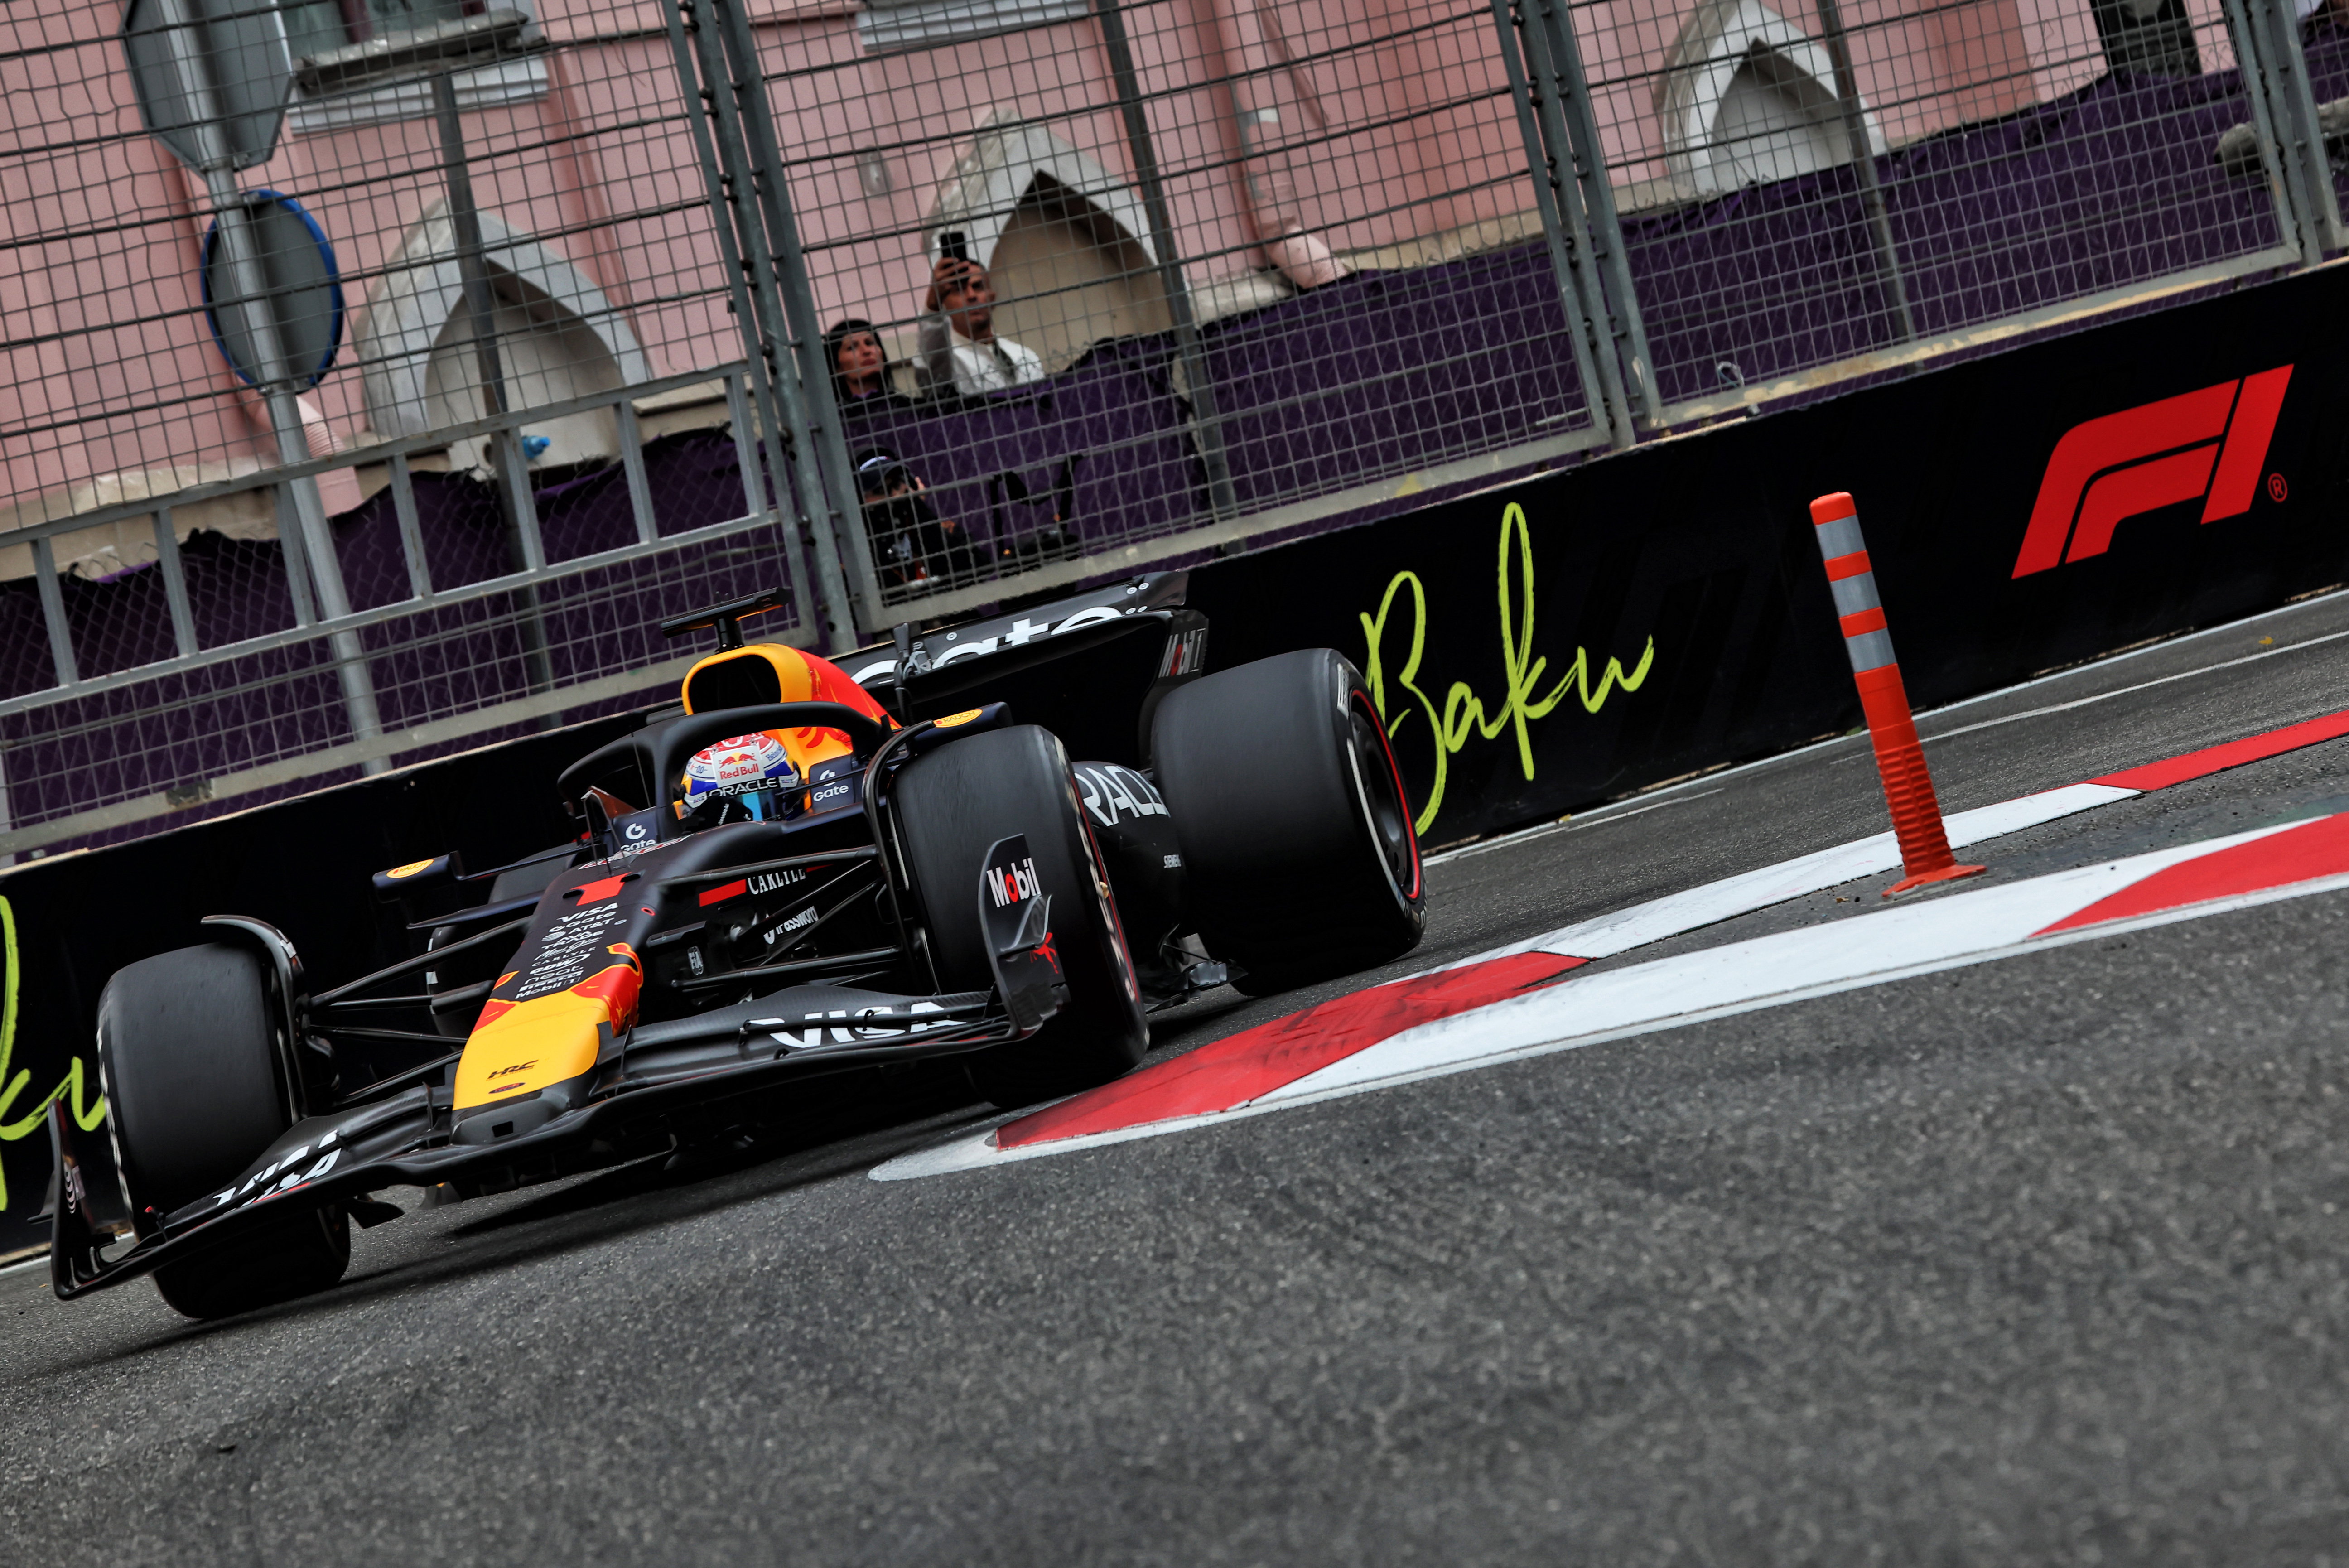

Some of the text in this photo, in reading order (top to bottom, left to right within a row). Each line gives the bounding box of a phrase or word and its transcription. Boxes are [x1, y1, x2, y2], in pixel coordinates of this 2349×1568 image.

[2011, 363, 2294, 579] F1
[1360, 502, 1654, 836] Baku
[943, 711, 975, 723] RAUCH
[719, 763, 759, 780] Red Bull
[709, 777, 778, 797] ORACLE
[813, 783, 849, 802] Gate
[1074, 765, 1171, 827] RACL
[620, 839, 657, 852] Gate
[986, 857, 1041, 908] Mobil
[557, 902, 618, 923] VISA
[566, 911, 617, 928] Gate
[568, 918, 615, 935] AT&T
[529, 955, 582, 975] CDW
[532, 946, 596, 967] CARLYLE
[515, 982, 562, 999] Mobil
[748, 1001, 967, 1048] VISA
[487, 1059, 539, 1080] HRC
